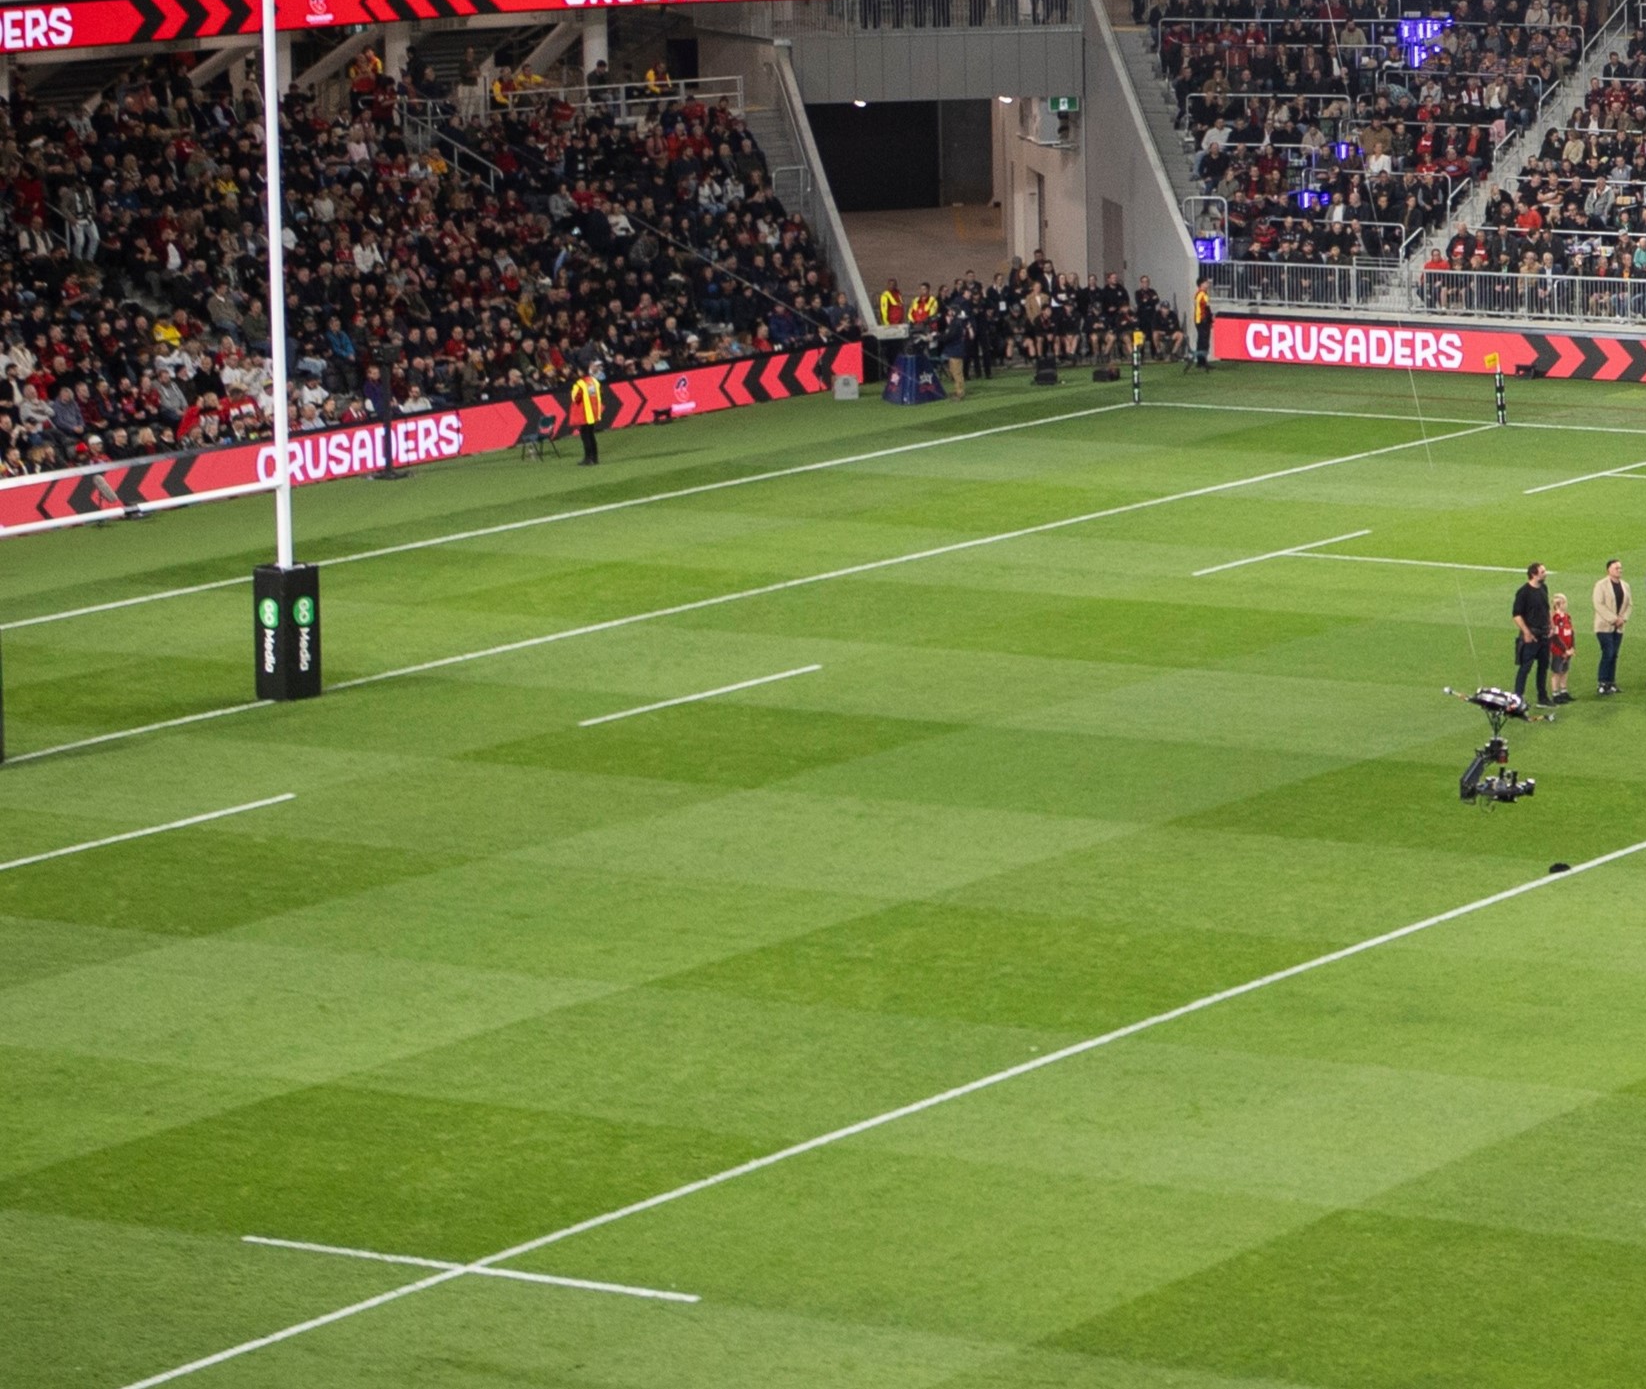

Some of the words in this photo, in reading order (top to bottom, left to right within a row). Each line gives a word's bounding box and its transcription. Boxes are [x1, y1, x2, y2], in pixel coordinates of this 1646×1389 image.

[0, 6, 73, 49] ERS
[1245, 323, 1463, 369] CRUSADERS
[264, 627, 276, 673] Media
[299, 626, 311, 672] Media
